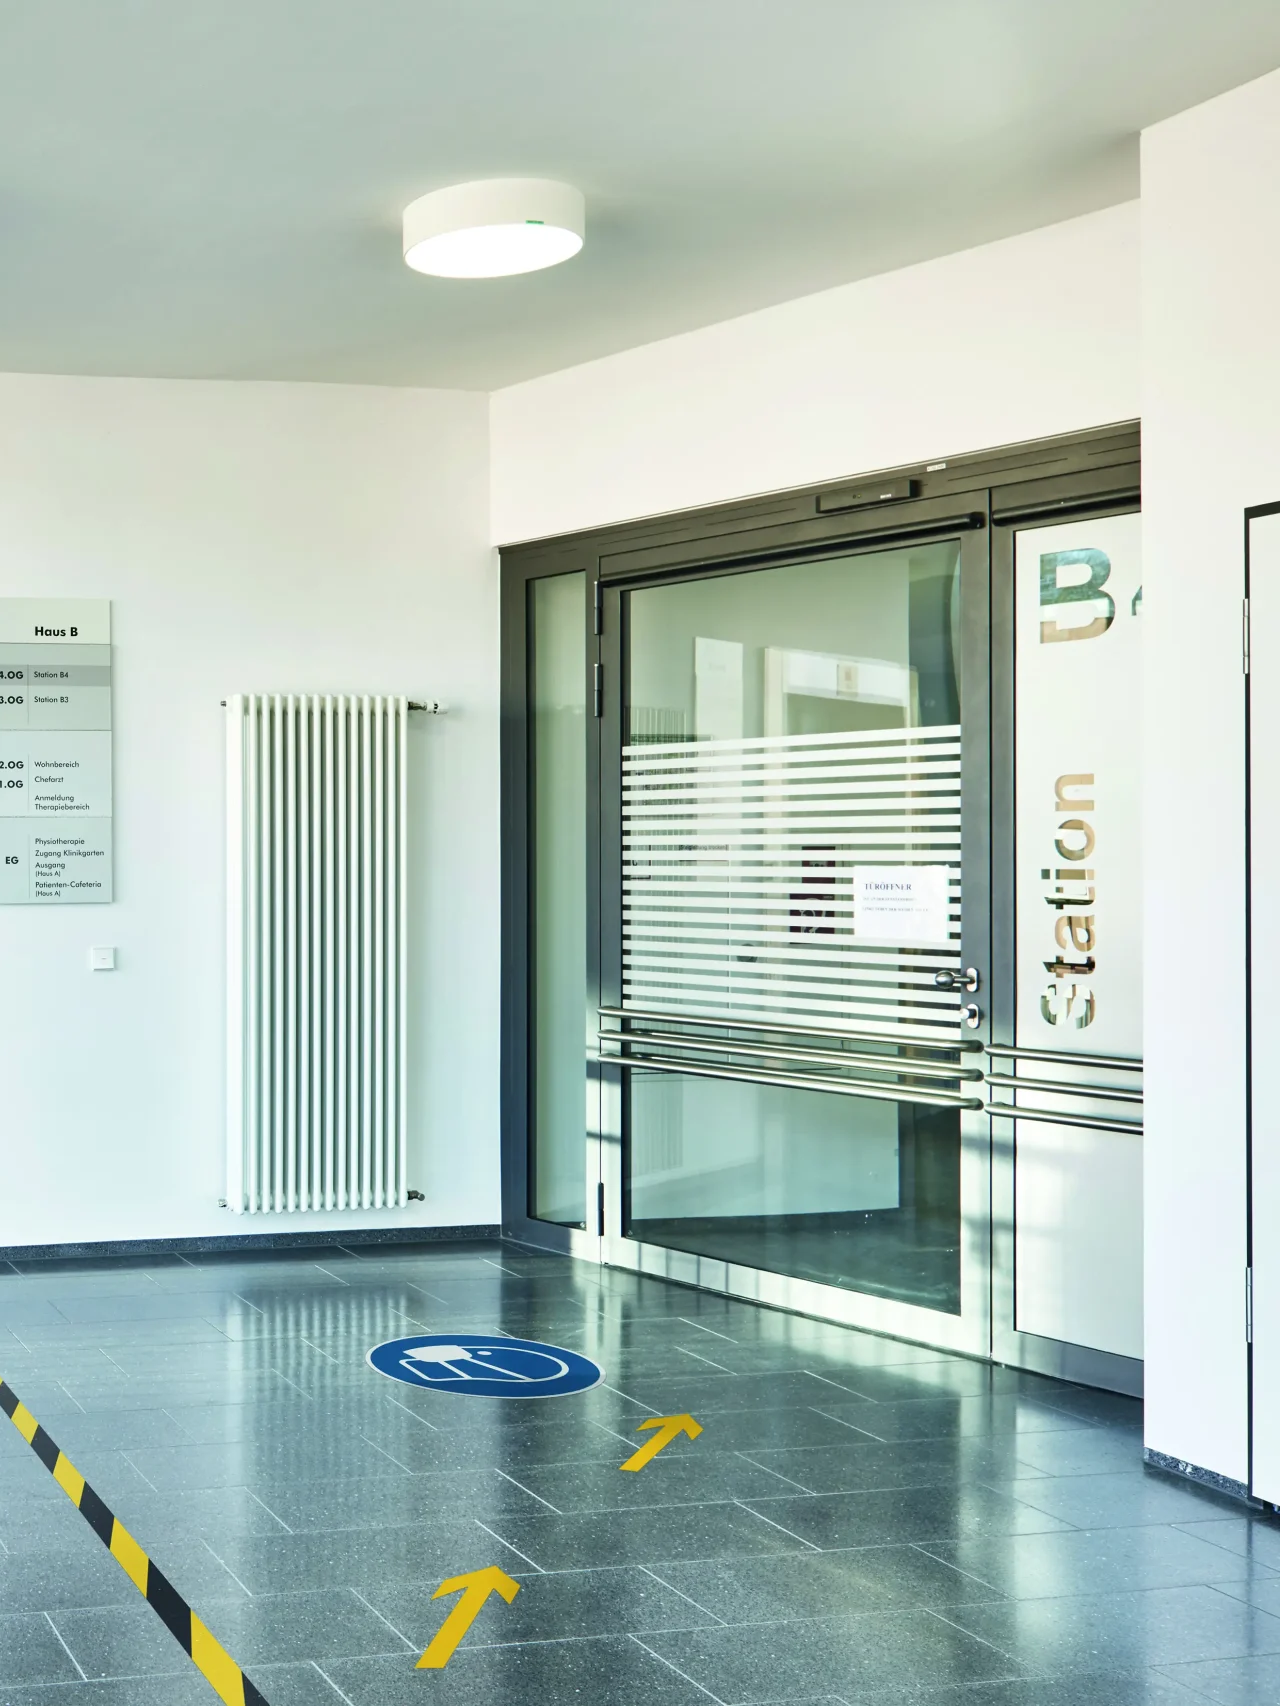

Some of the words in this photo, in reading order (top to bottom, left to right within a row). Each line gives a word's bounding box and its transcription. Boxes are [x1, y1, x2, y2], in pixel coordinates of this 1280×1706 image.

[1040, 547, 1142, 644] B
[34, 626, 66, 637] Haus
[70, 626, 78, 637] B
[34, 671, 58, 679] Station
[60, 671, 69, 679] B4
[35, 838, 85, 846] Physiotherapie
[35, 850, 61, 858] Zugang
[63, 850, 104, 858] Klinikgarten
[5, 856, 19, 864] EG
[1040, 773, 1095, 1030] Station
